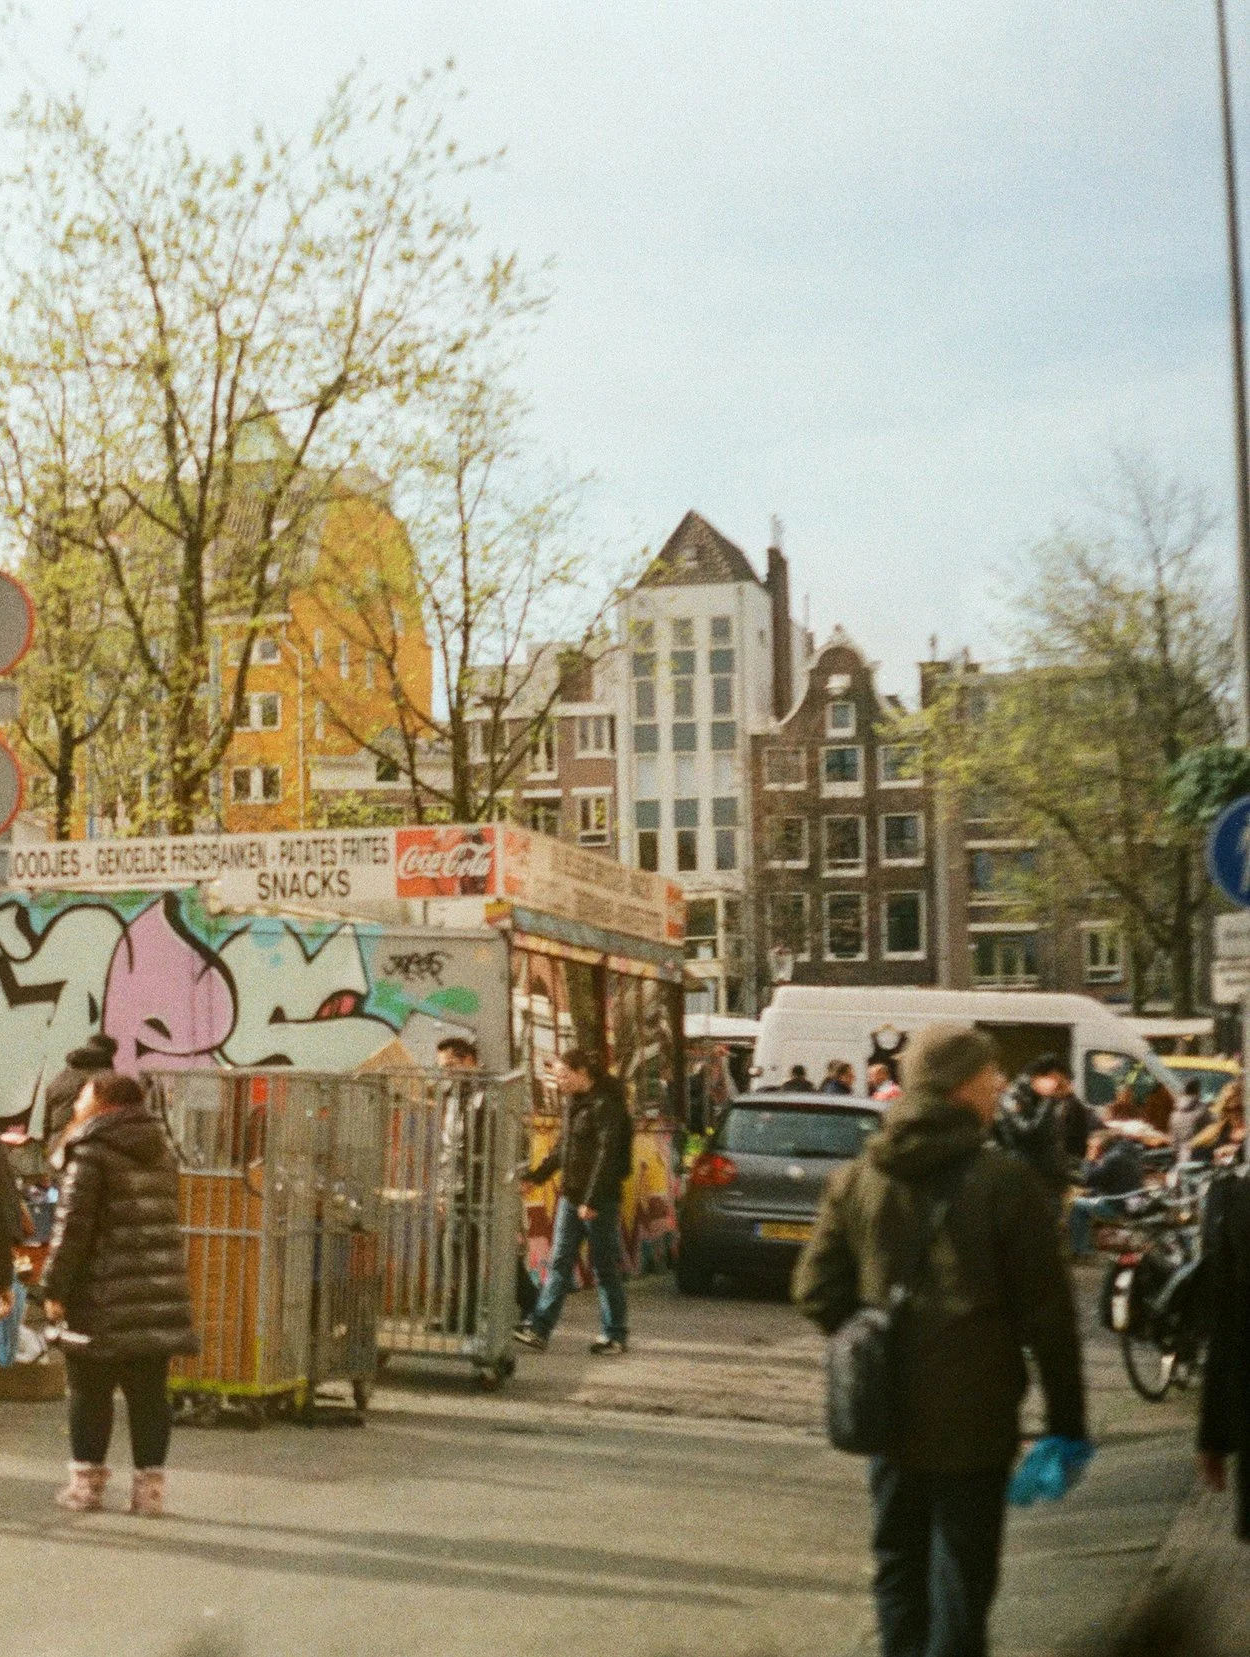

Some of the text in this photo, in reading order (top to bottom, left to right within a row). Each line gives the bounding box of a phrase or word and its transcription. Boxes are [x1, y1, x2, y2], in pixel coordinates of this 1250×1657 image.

[8, 849, 81, 879] OODJES
[96, 846, 167, 875] GEKOELDE
[257, 869, 351, 901] SNACKS
